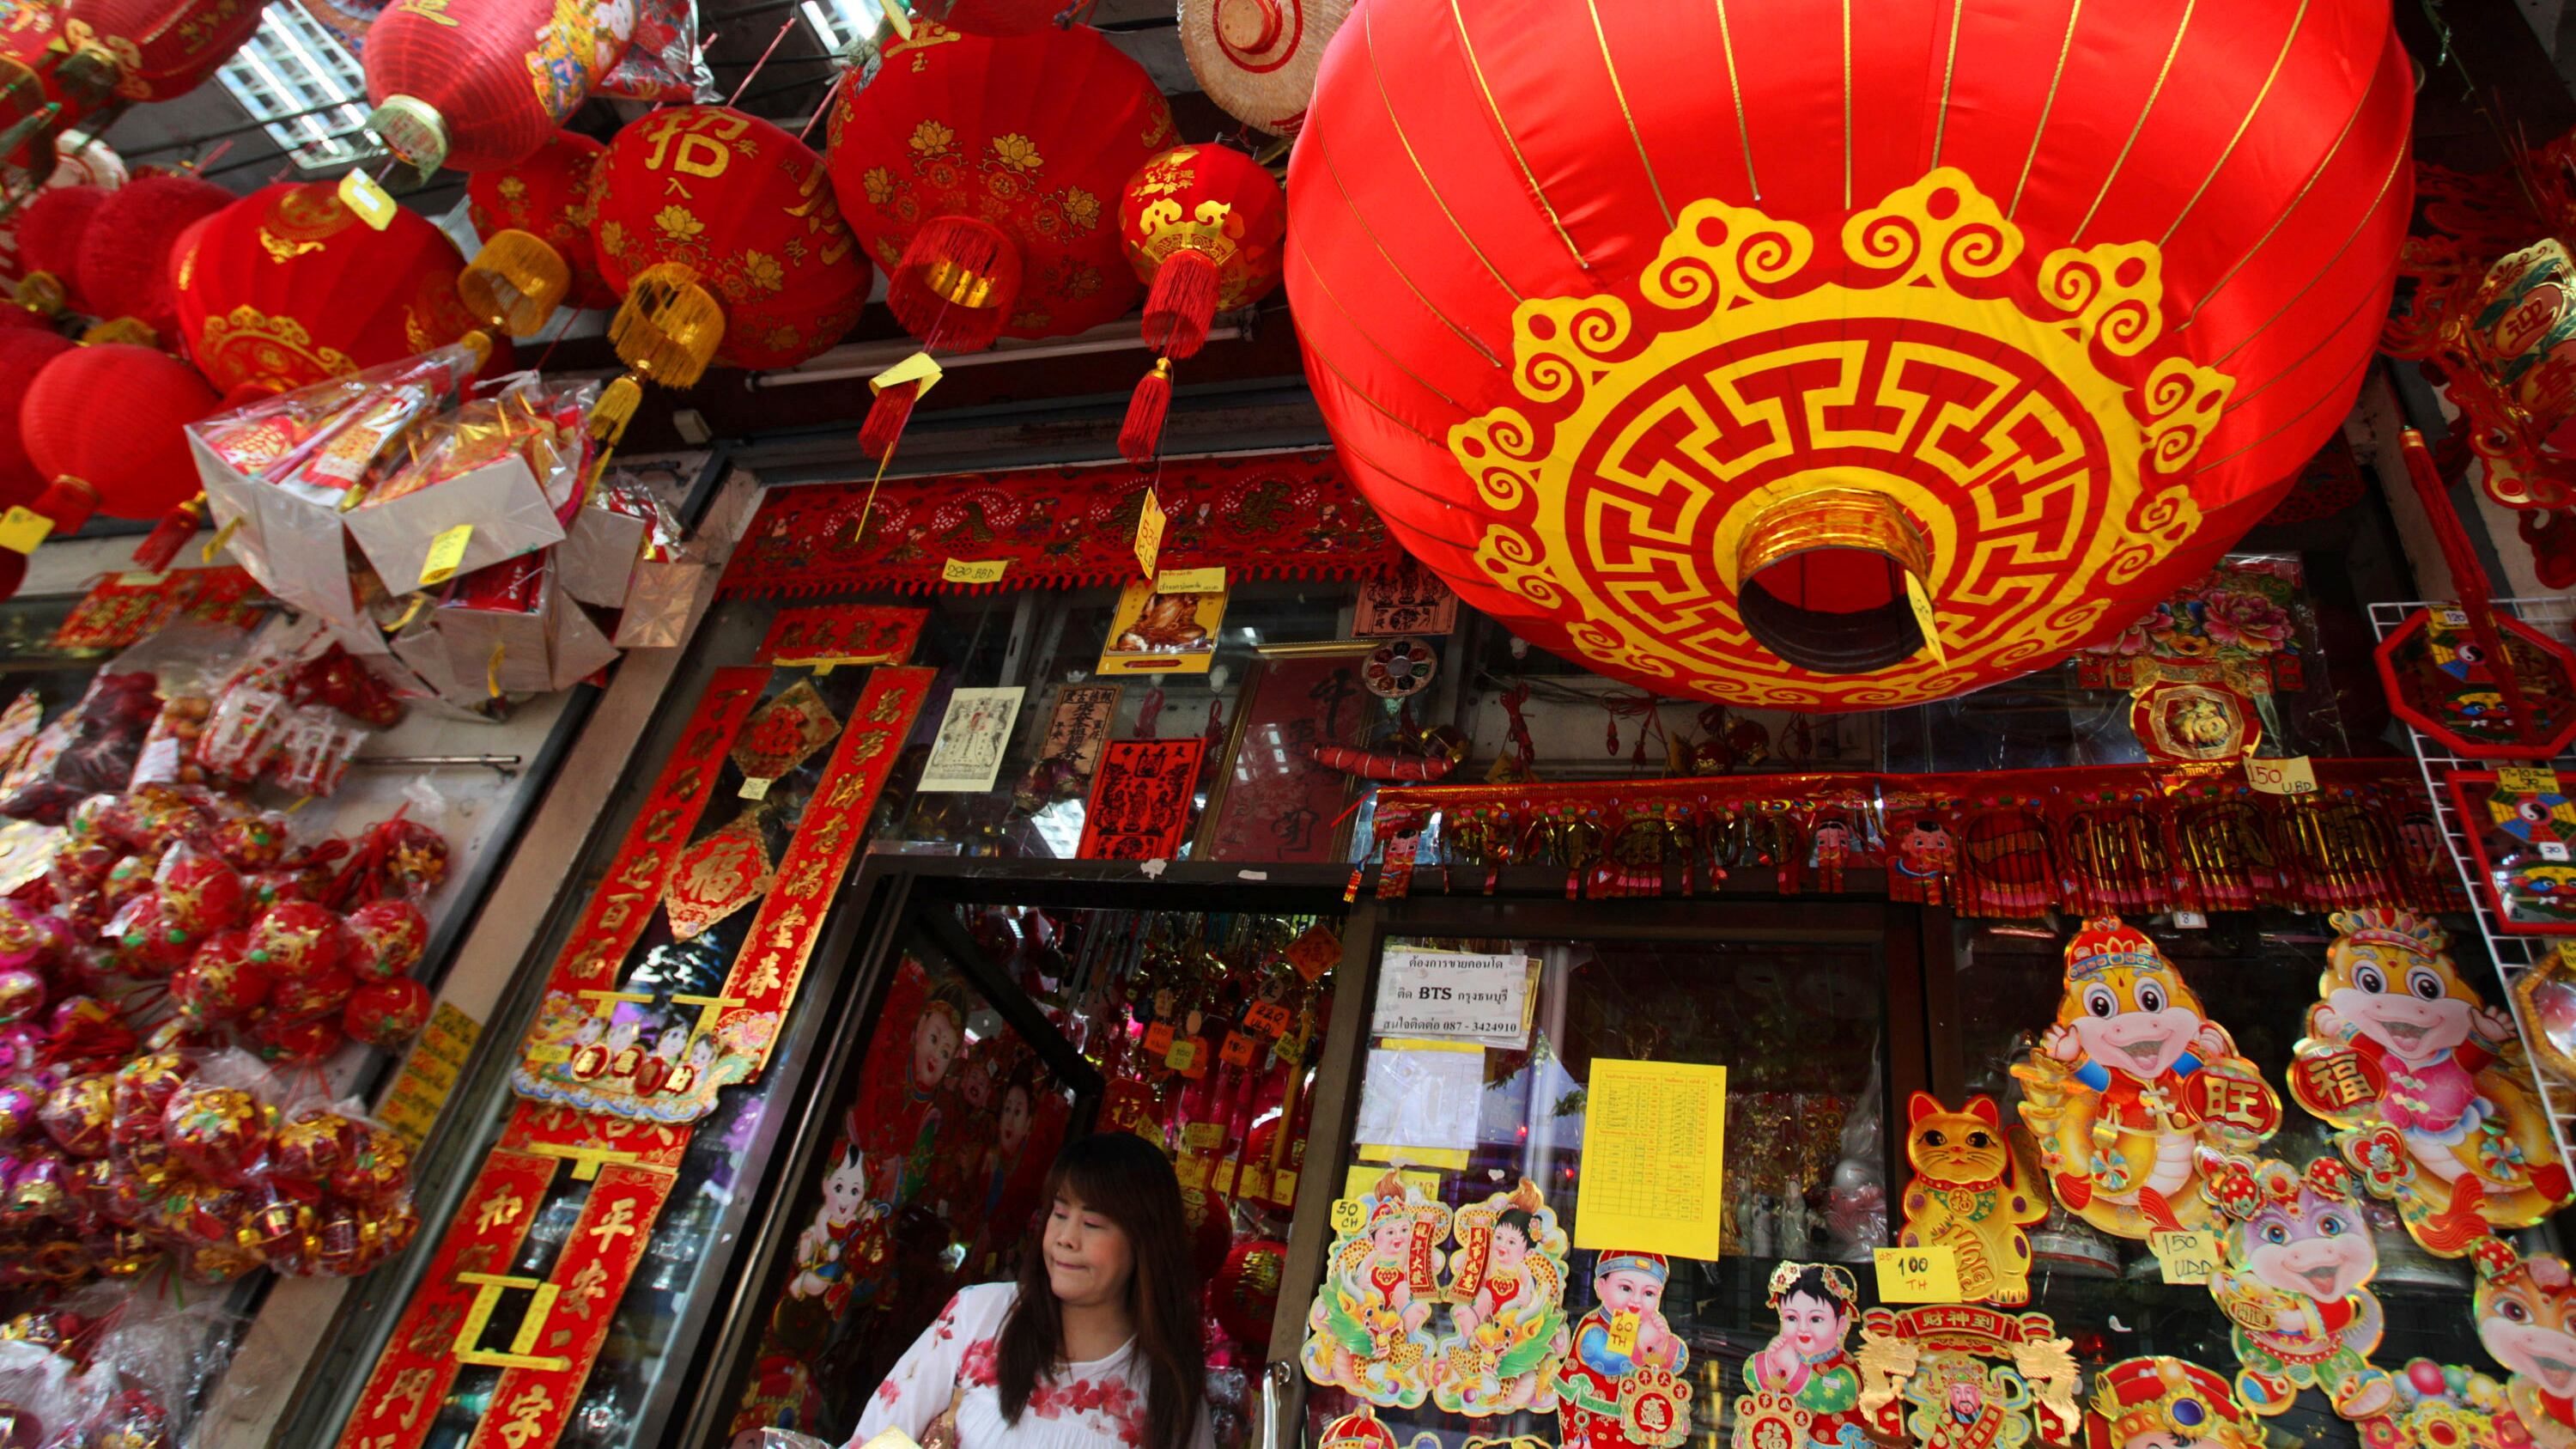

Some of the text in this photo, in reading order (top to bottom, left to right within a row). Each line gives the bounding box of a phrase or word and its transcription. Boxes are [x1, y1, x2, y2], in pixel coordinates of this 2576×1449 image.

[645, 107, 751, 179] 招
[2247, 763, 2282, 784] 150
[683, 840, 752, 903] 福
[1419, 987, 1452, 1001] BTS
[1443, 1022, 1461, 1032] 087
[1473, 1022, 1517, 1032] 3424910
[2307, 1052, 2376, 1108] 福
[2203, 1075, 2266, 1135] 旺
[1336, 1201, 1358, 1216] 50
[1341, 1217, 1358, 1228] CH
[2161, 1234, 2198, 1255] 150
[1898, 1257, 1929, 1276] 100
[1905, 1279, 1928, 1291] TH
[1616, 1319, 1633, 1333] 60
[1922, 1310, 1996, 1331] 财神到
[1611, 1333, 1627, 1347] TH
